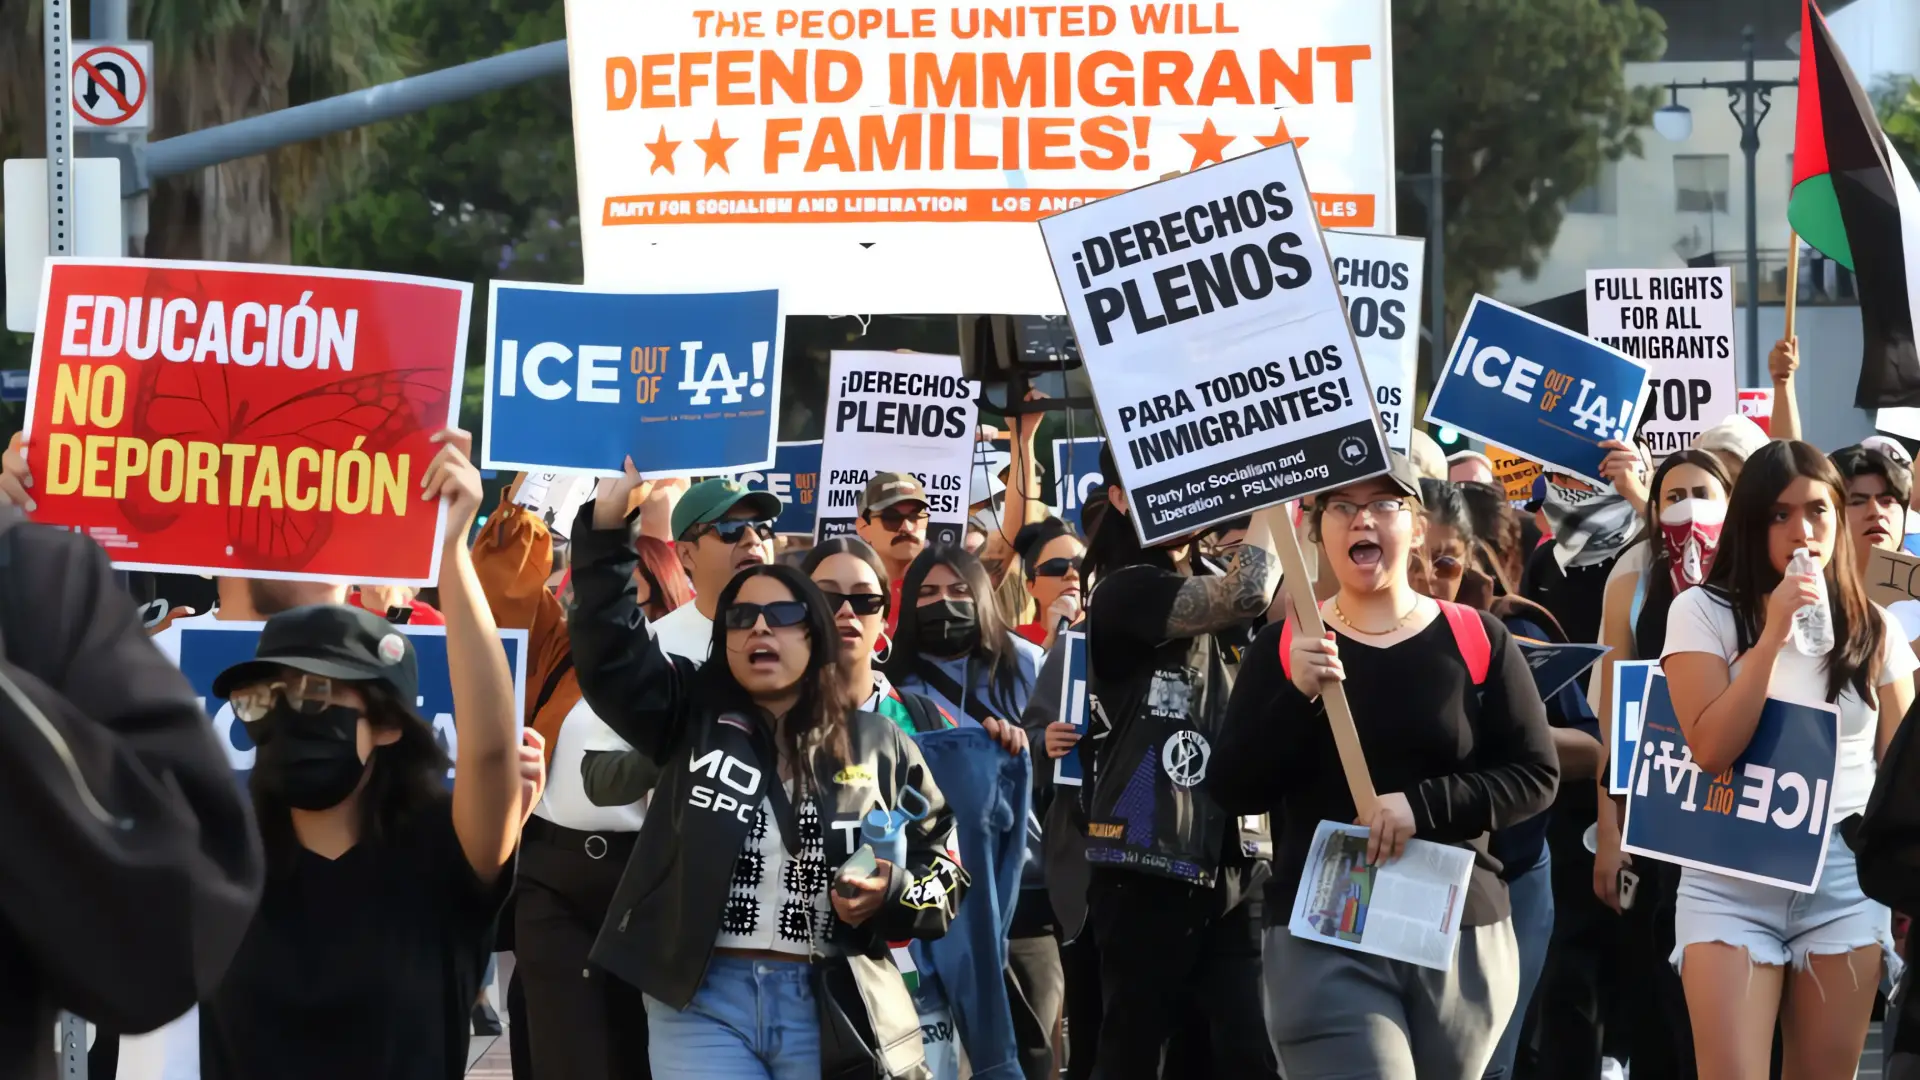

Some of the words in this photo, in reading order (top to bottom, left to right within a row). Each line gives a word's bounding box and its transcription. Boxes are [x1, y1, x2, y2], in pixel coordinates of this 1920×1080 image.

[693, 10, 765, 38] THE
[776, 8, 936, 40] PEOPLE
[951, 5, 1116, 39] UNITED
[1130, 2, 1239, 35] WILL
[605, 49, 863, 111] DEFEND
[889, 44, 1372, 109] IMMIGRANT
[763, 113, 1151, 174] FAMILIES!
[609, 201, 655, 218] PARTY
[659, 200, 691, 216] FOR
[696, 198, 793, 215] SOCIALISM
[798, 196, 838, 213] AND
[845, 196, 968, 212] LIBERATION
[991, 196, 1031, 212] LOS
[1320, 201, 1358, 217] LES
[1071, 181, 1294, 290] ¡DERECHOS
[1084, 231, 1313, 347] PLENOS
[1332, 257, 1409, 291] CHOS
[1594, 277, 1643, 301] FULL
[1649, 275, 1724, 301] RIGHTS
[59, 290, 359, 372] EDUCACIÓN
[1344, 295, 1406, 340] OS
[1620, 306, 1658, 330] FOR
[1665, 306, 1702, 329] ALL
[630, 346, 671, 374] OUT
[1594, 335, 1730, 360] MMIGRANTS
[500, 339, 622, 404] ICE
[840, 370, 971, 399] ¡DERECHOS
[1117, 388, 1194, 433] PARA
[1194, 361, 1285, 407] TODOS
[1288, 344, 1342, 383] LOS
[1453, 336, 1544, 404] ICE
[1543, 368, 1575, 396] OUT
[51, 363, 127, 429] NO
[636, 376, 662, 404] OF
[1377, 385, 1402, 406] OS
[1540, 391, 1563, 413] OF
[1648, 378, 1712, 422] TOP
[836, 400, 967, 439] PLENOS
[1127, 376, 1354, 471] INMIGRANTES!
[1647, 431, 1701, 451] RTATI
[45, 433, 410, 517] DEPORTACIÓN
[727, 471, 793, 504] CE
[830, 469, 869, 485] PARA
[931, 474, 962, 491] LOS
[1064, 471, 1105, 510] IC
[1146, 489, 1184, 510] Party
[1186, 481, 1206, 497] for
[1207, 460, 1277, 489] Socialism
[1279, 450, 1306, 469] and
[1151, 493, 1224, 526] Liberation
[1241, 464, 1330, 498] PSLWeb.org
[1703, 783, 1734, 815] OUT
[1736, 763, 1828, 836] ICE
[831, 820, 862, 855] T
